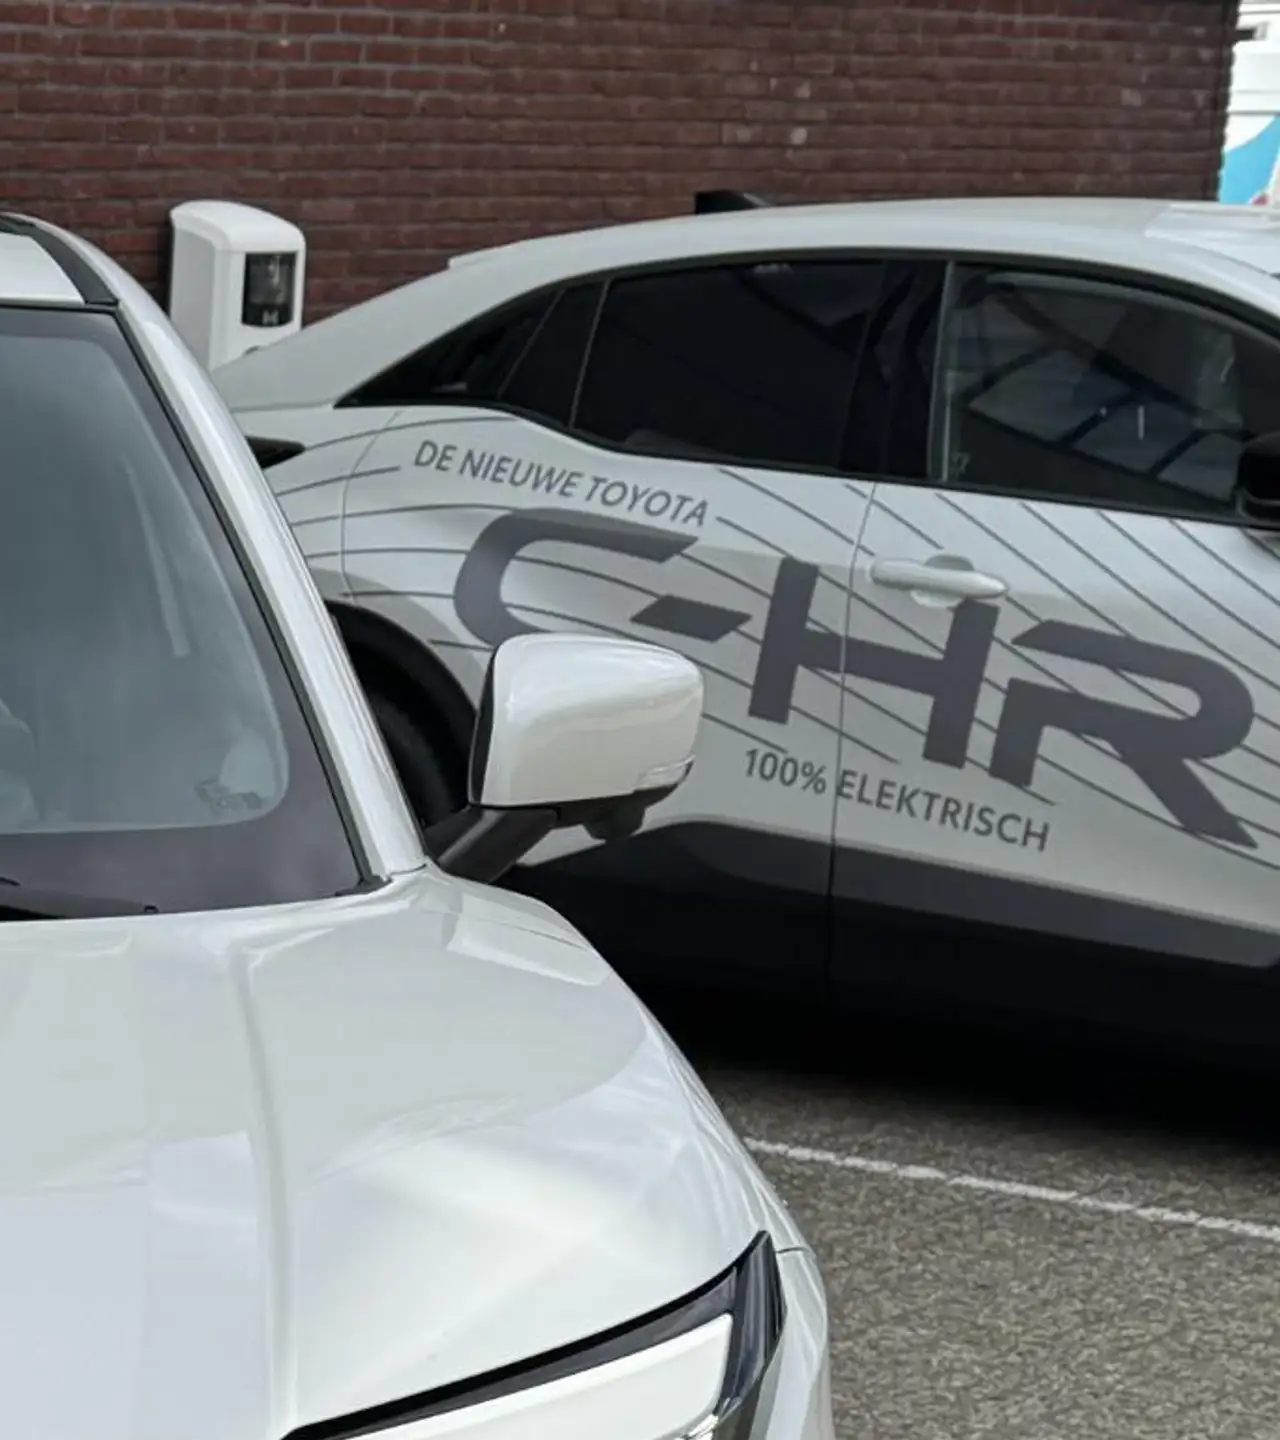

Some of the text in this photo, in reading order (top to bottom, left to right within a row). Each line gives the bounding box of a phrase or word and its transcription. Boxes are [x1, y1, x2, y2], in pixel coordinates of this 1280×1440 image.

[414, 440, 711, 529] DE NIEUWE TOYOTA
[454, 508, 1258, 849] C-HR
[744, 748, 1050, 852] 100% ELEKTRISCH
